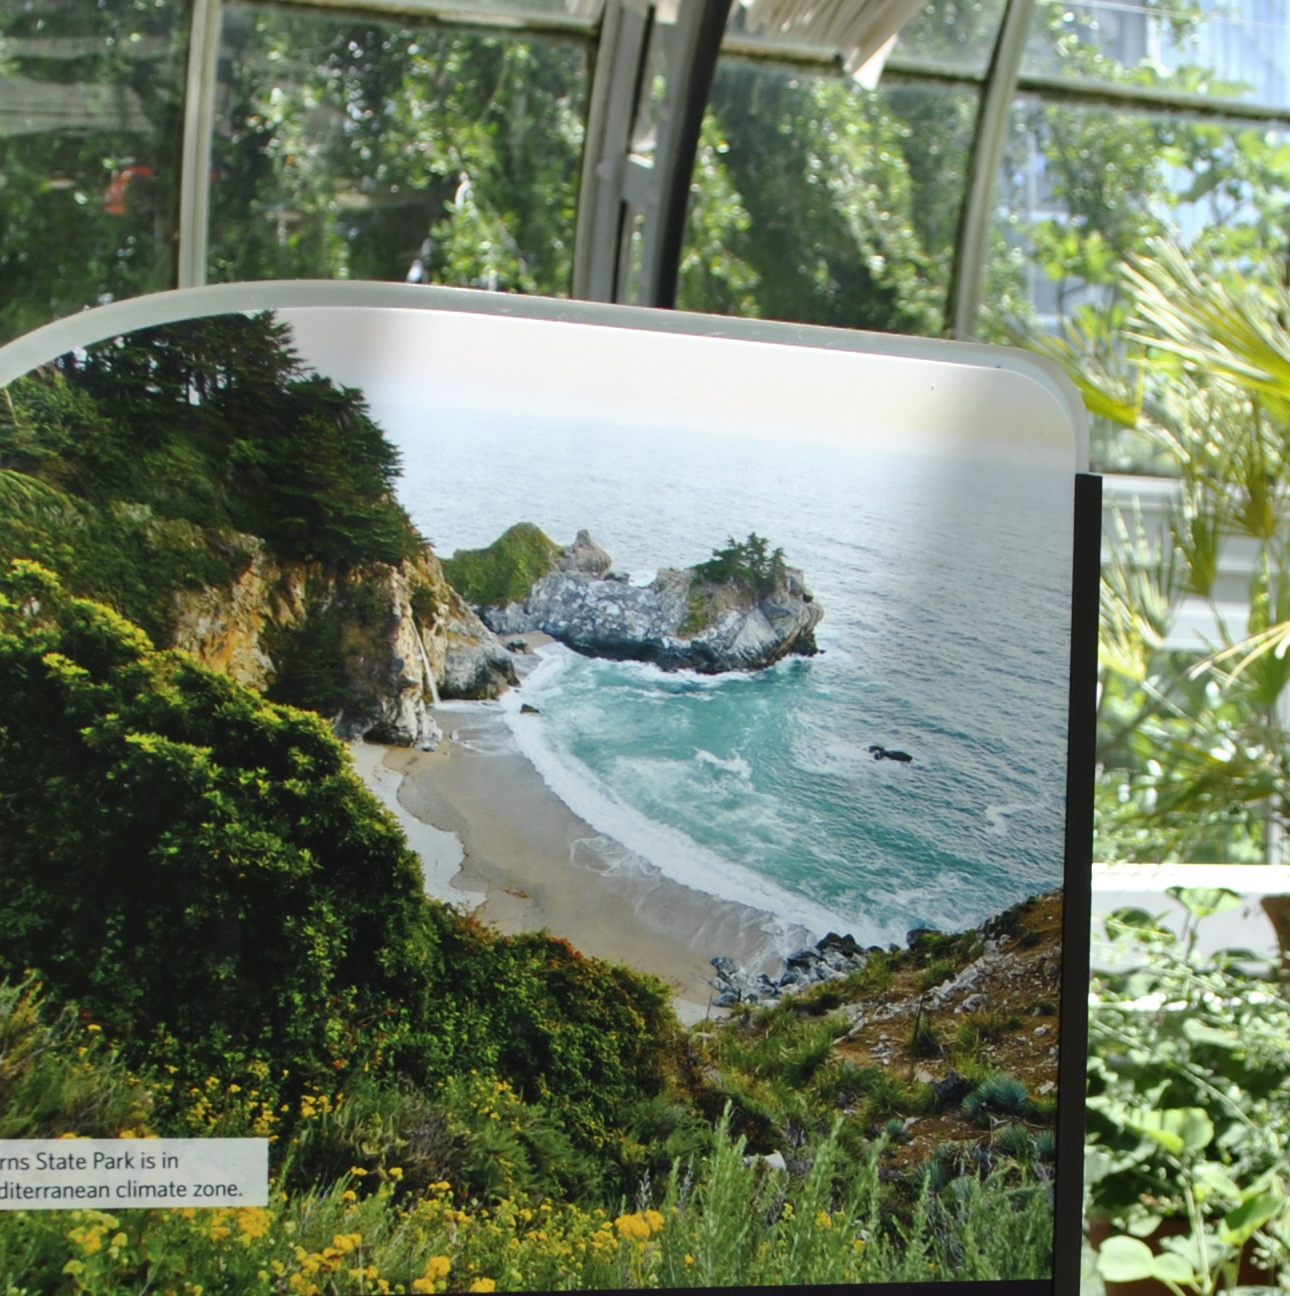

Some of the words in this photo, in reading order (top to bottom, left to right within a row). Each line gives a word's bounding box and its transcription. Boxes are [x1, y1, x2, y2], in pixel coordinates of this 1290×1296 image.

[36, 1152, 87, 1170] State
[93, 1152, 135, 1169] Park
[141, 1152, 156, 1169] is
[162, 1152, 178, 1169] in
[116, 1180, 187, 1198] climate
[193, 1184, 242, 1197] zone.
